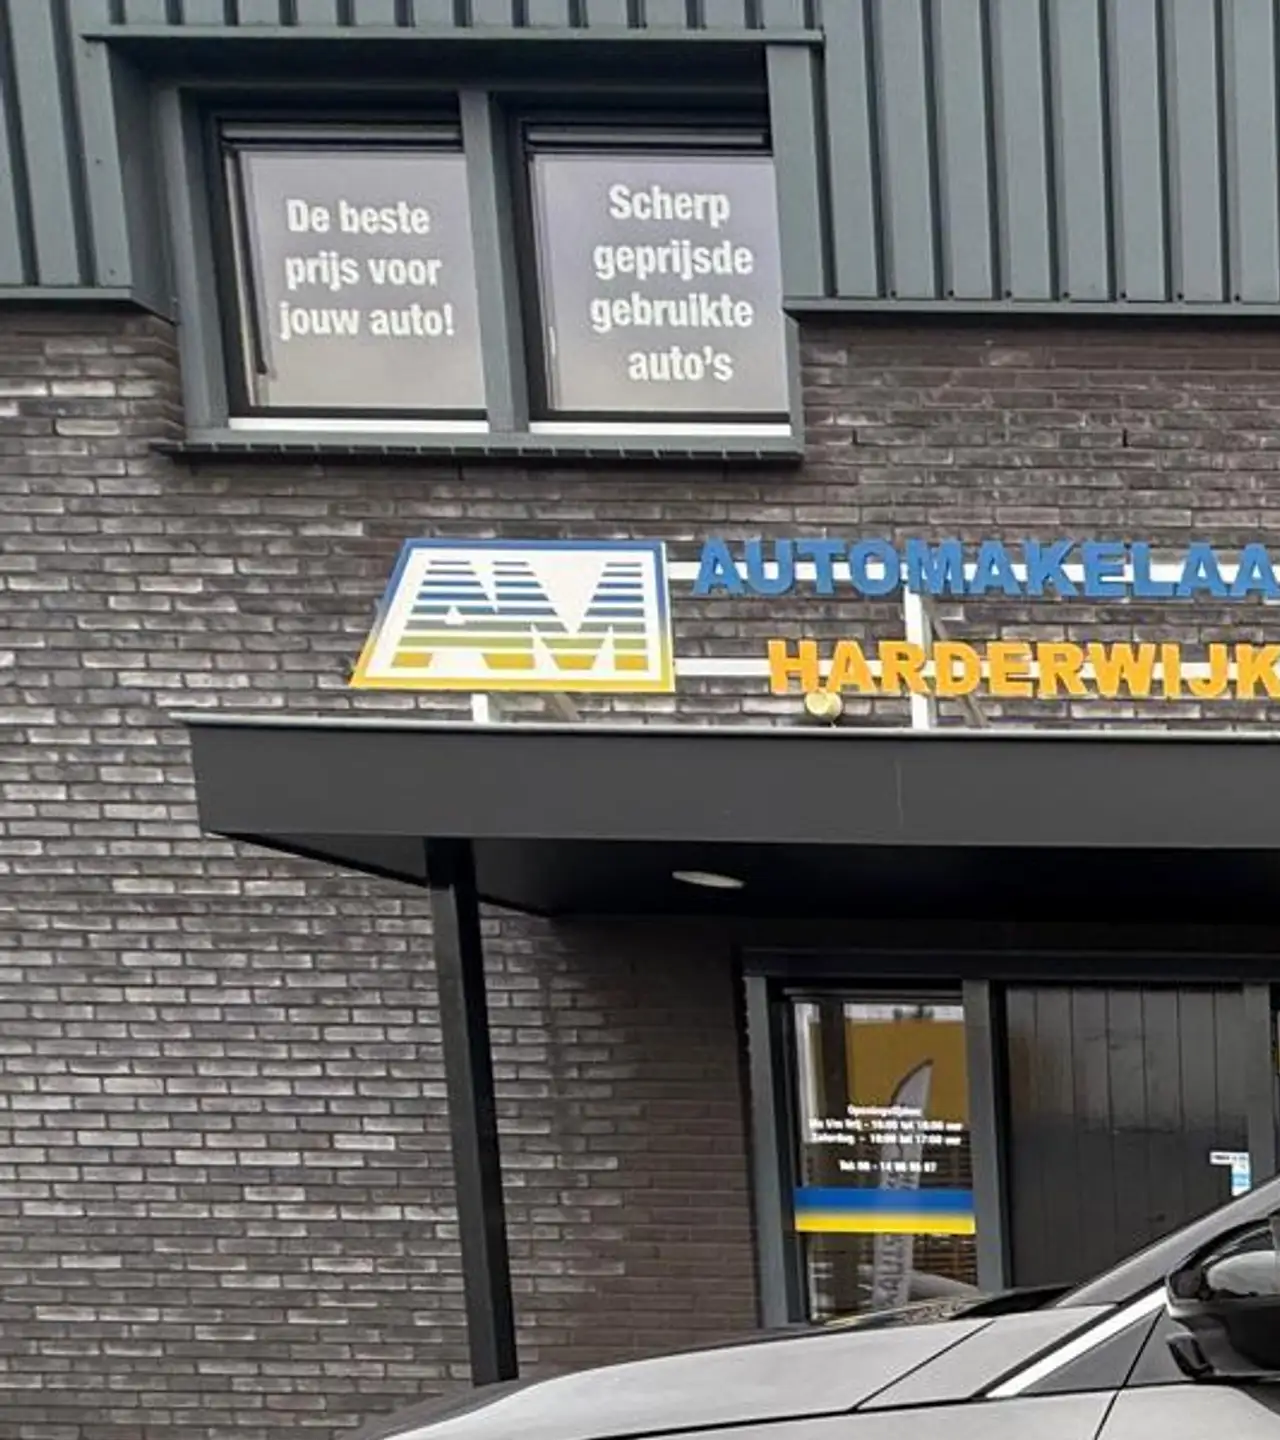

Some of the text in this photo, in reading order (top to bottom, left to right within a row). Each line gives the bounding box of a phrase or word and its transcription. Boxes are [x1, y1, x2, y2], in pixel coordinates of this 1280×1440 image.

[286, 198, 430, 234] De beste
[609, 184, 731, 229] Scherp
[284, 251, 443, 291] prijs voor
[593, 239, 754, 281] geprijsde
[279, 301, 455, 341] jouw auto!
[590, 292, 754, 334] gebruikte
[390, 559, 650, 671] AM
